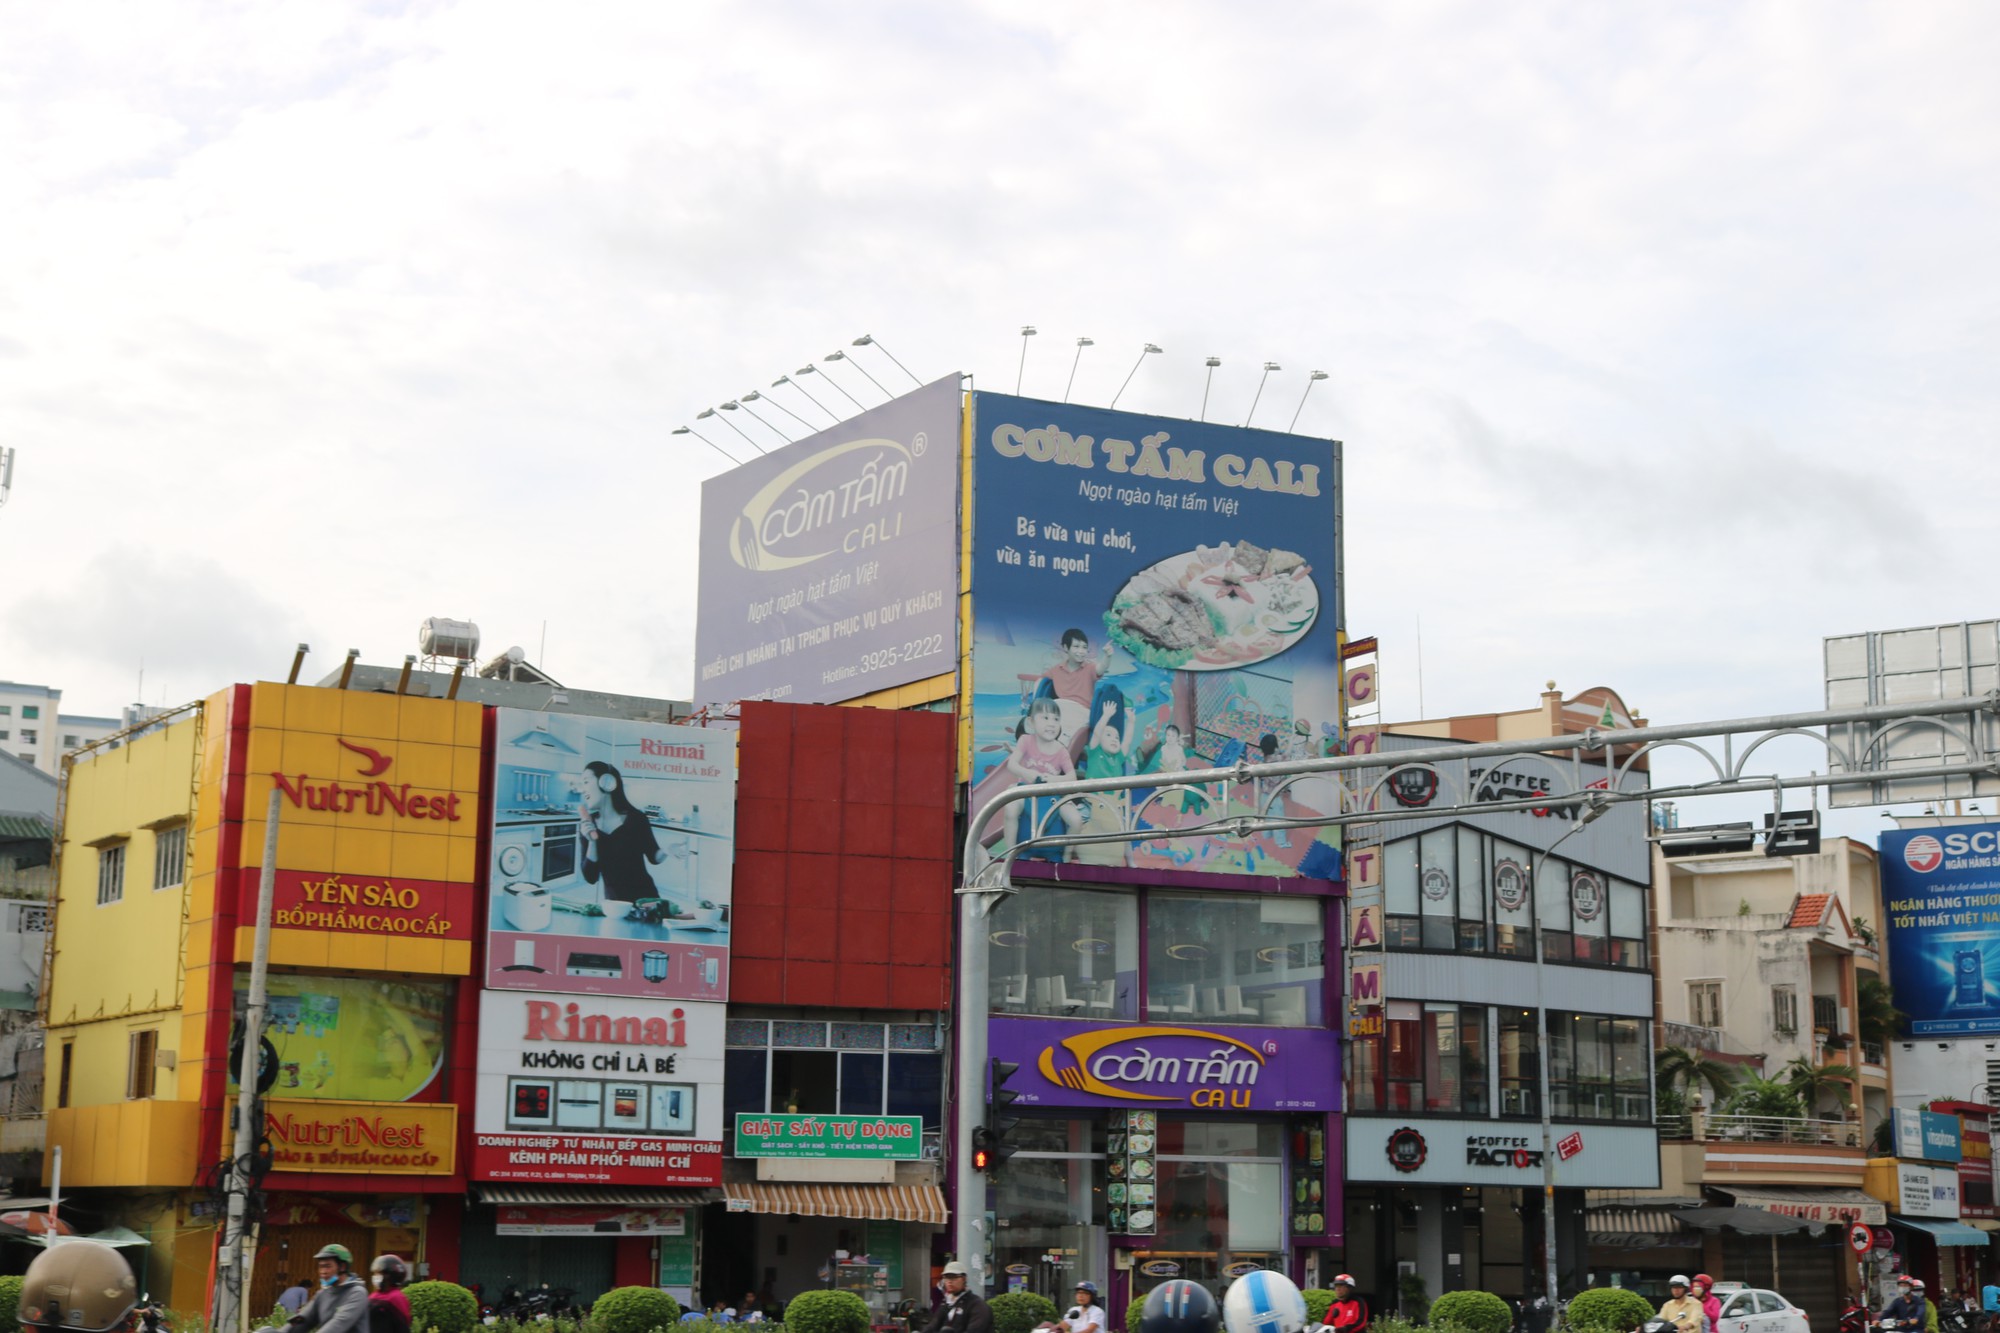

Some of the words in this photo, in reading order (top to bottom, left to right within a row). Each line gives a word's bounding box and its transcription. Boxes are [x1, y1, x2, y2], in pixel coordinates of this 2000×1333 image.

[992, 424, 1095, 468] CƠM
[1101, 432, 1206, 483] TẤM
[1213, 454, 1320, 496] CALI
[762, 489, 835, 546] CƠM
[839, 451, 908, 519] TẤM
[1078, 480, 1112, 502] Ngọt
[1116, 487, 1151, 508] ngào
[1155, 489, 1178, 510] hạt
[1181, 492, 1208, 511] tấm
[1213, 497, 1239, 518] Việt
[843, 512, 902, 553] CALI
[1017, 516, 1036, 537] Bé
[1043, 522, 1068, 542] vừa
[1074, 527, 1095, 546] vui
[1102, 528, 1136, 553] chơi,
[996, 546, 1021, 566] vừa
[1028, 550, 1045, 568] ăn
[1052, 553, 1090, 577] ngon!
[748, 601, 774, 624] Ngọt
[776, 588, 804, 616] ngào
[806, 579, 825, 602] hạt
[828, 568, 851, 596] tấm
[856, 561, 880, 586] Việt
[702, 653, 727, 682] NHIỀU
[729, 653, 744, 673] CHI
[746, 641, 777, 666] NHÁNH
[780, 639, 795, 657] TẠI
[798, 625, 831, 650] TPHCM
[833, 618, 860, 639] PHỤC
[863, 611, 877, 630] VỤ
[880, 601, 902, 624] QUÝ
[905, 590, 943, 617] KHÁCH
[822, 665, 858, 685] Hotline:
[860, 634, 943, 674] 3925-2222
[640, 738, 706, 760] Rinnai
[624, 760, 661, 771] KHÔNG
[663, 763, 682, 774] CHỈ
[684, 765, 698, 775] LÀ
[700, 765, 720, 777] BẾP
[271, 772, 461, 821] NutriNest
[1944, 831, 2000, 855] SC
[1945, 856, 1968, 870] NGÂN
[1968, 854, 1991, 868] HÀNG
[301, 875, 359, 905] YẾN
[362, 881, 420, 909] SÀO
[1501, 889, 1518, 897] TCF
[1578, 899, 1593, 908] TCF
[1890, 897, 1924, 912] NGÂN
[1927, 895, 1962, 910] HÀNG
[1893, 913, 1916, 928] TỐT
[1918, 912, 1951, 927] NHẤT
[1952, 911, 1979, 927] VIỆT
[1982, 911, 2000, 923] NA
[523, 1000, 688, 1047] Rinnai
[1350, 1013, 1383, 1037] CALI
[522, 1050, 584, 1070] KHÔNG
[592, 1051, 620, 1072] CHỈ
[627, 1053, 648, 1073] LÀ
[655, 1053, 677, 1074] BẾ
[1092, 1047, 1181, 1083] CƠM
[1181, 1044, 1260, 1086] TẤM
[266, 1112, 425, 1148] NutriNest
[741, 1118, 784, 1140] GIẶT
[789, 1117, 826, 1137] SẤY
[831, 1120, 858, 1140] TỰ
[861, 1119, 913, 1140] ĐỘNG
[1479, 1136, 1529, 1147] COFFEE
[478, 1136, 515, 1147] DOANH
[518, 1137, 559, 1151] NGHIỆP
[563, 1138, 578, 1149] TƯ
[582, 1138, 614, 1150] NHÂN
[618, 1136, 637, 1151] BẾP
[641, 1141, 662, 1152] GAS
[666, 1142, 692, 1153] MINH
[694, 1142, 722, 1154] CHÂU
[509, 1150, 546, 1165] KÊNH
[549, 1152, 587, 1166] PHÂN
